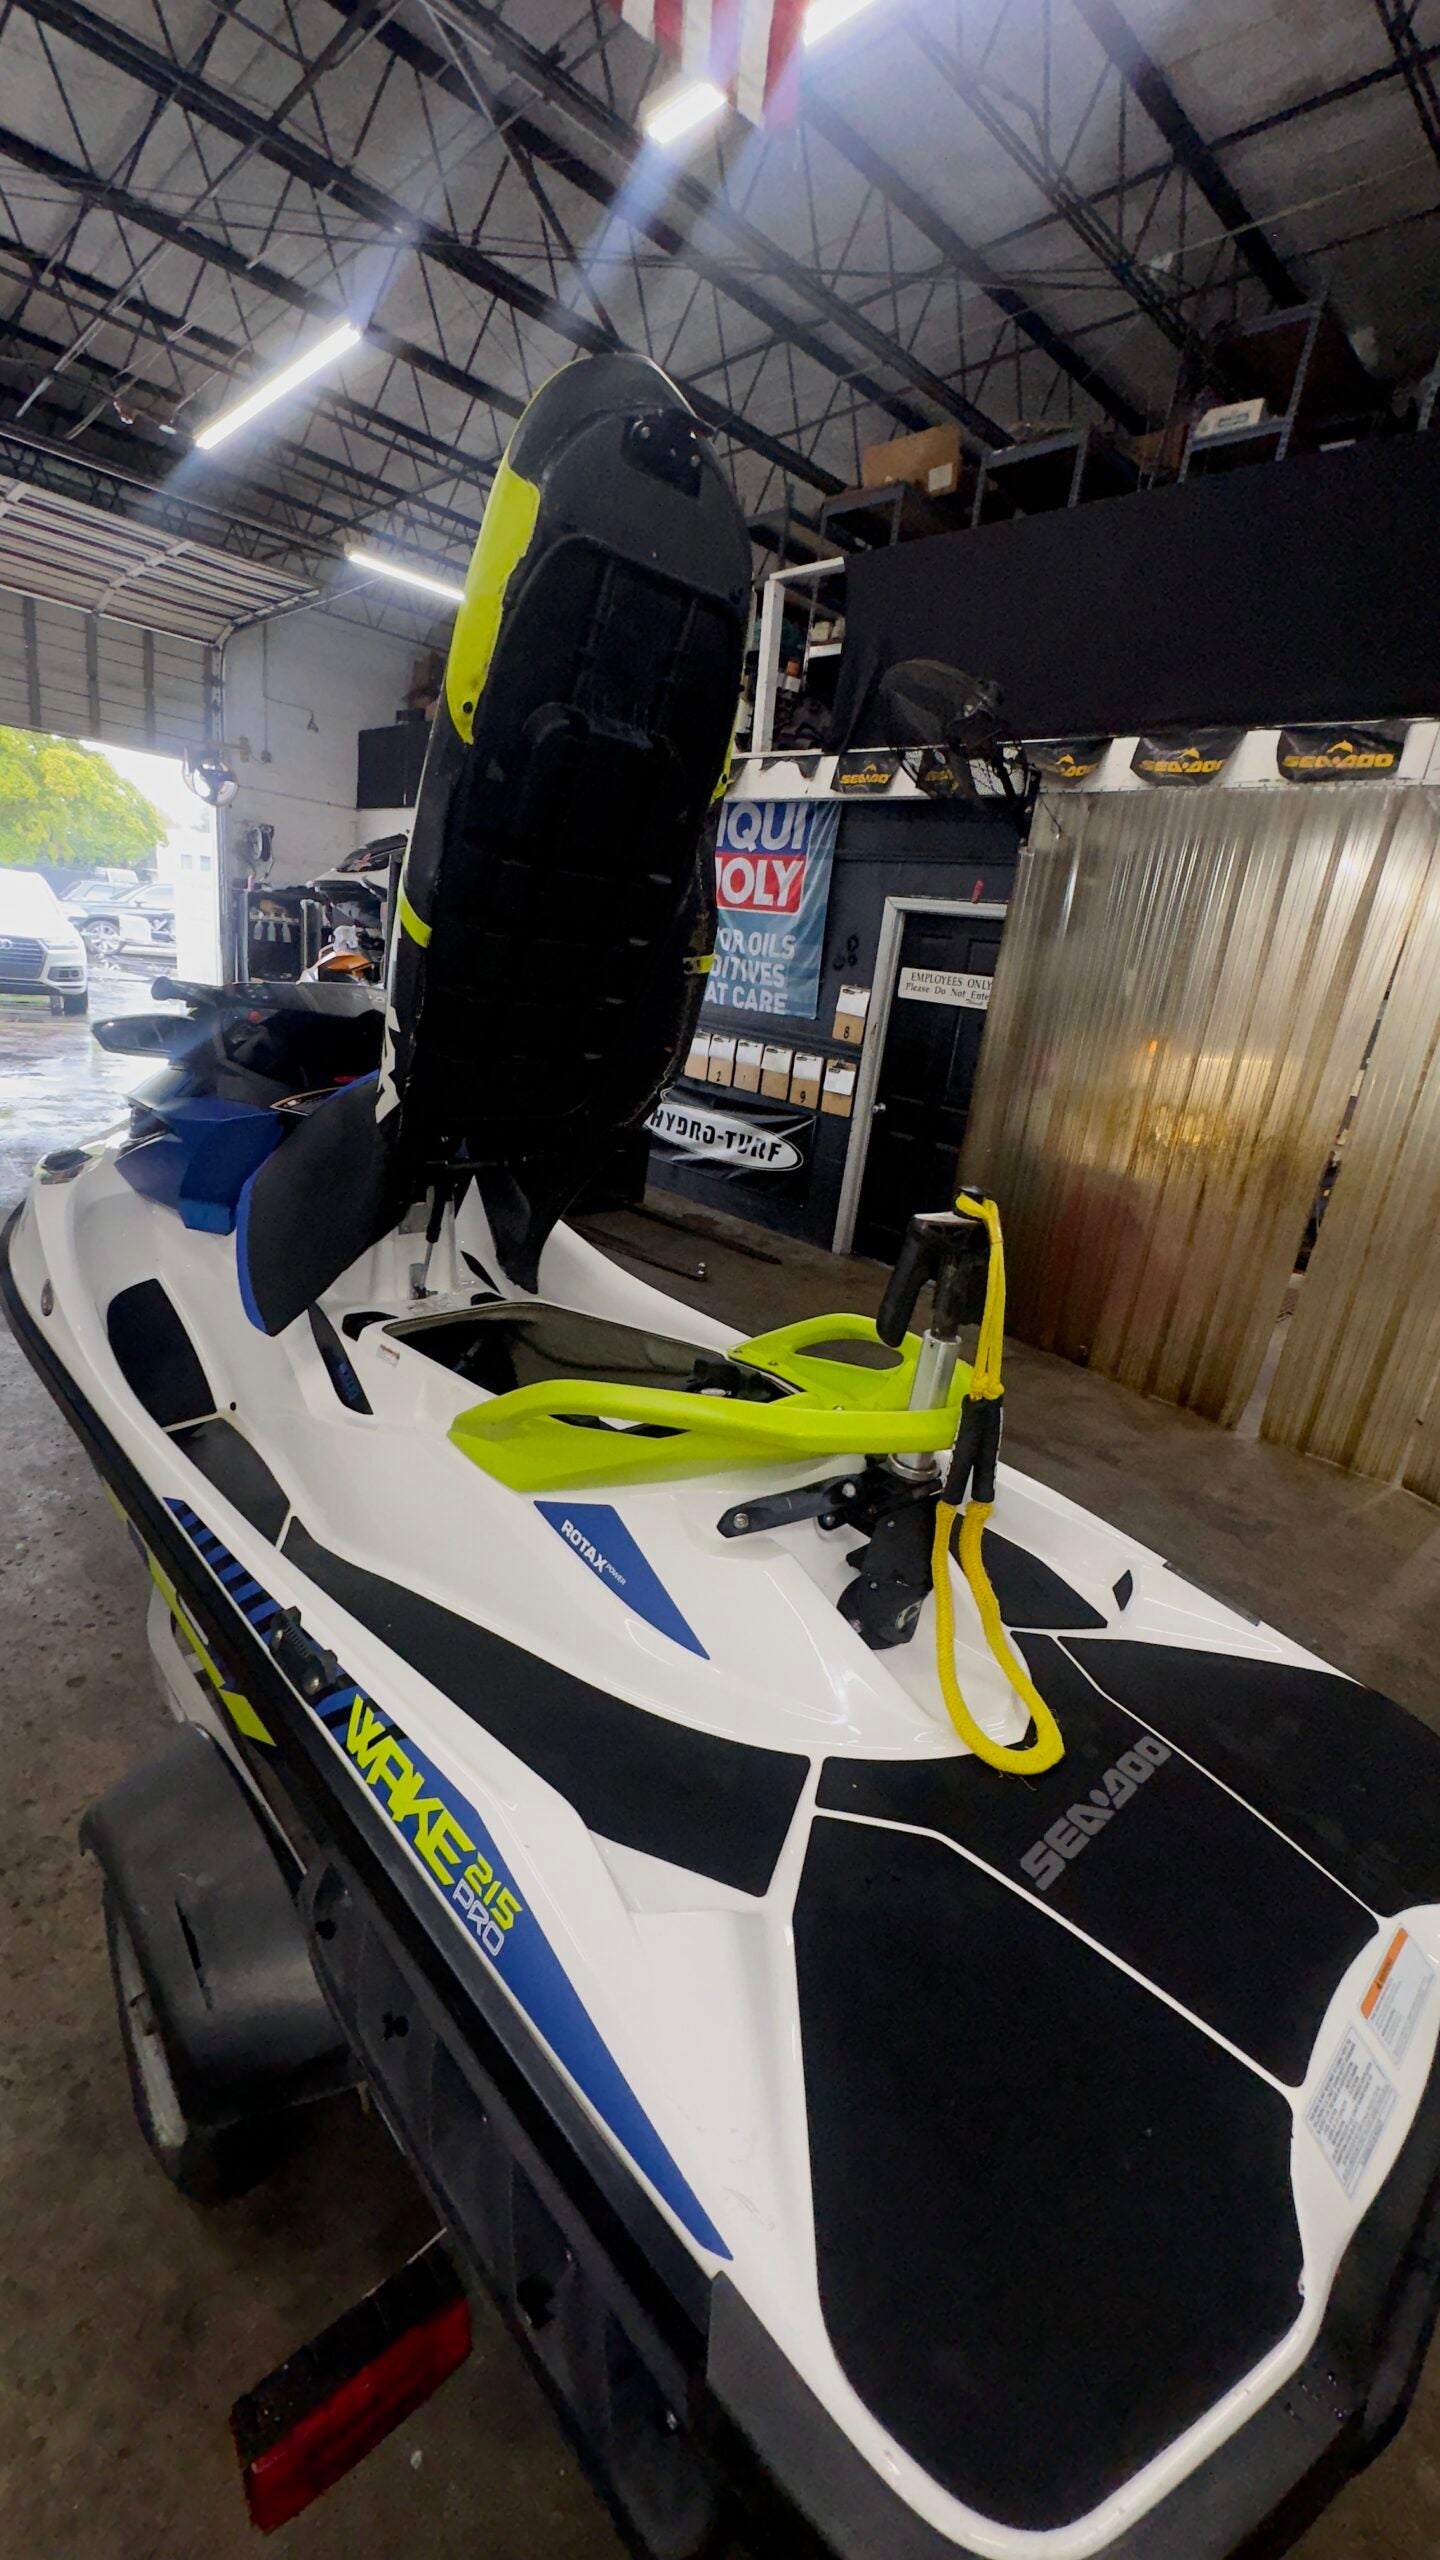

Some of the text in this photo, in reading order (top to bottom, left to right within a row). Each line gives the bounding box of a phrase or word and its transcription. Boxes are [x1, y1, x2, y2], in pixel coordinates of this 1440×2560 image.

[716, 801, 809, 853] IQUI
[715, 856, 804, 906] OLY
[749, 931, 797, 960] OILS
[733, 985, 788, 1015] CARE
[905, 982, 989, 1001] Please Do Not Ente
[911, 972, 993, 991] EMPLOYEES ONLY
[843, 1025, 850, 1039] 8
[800, 1090, 807, 1103] 9
[650, 1108, 783, 1162] HYDRO-TURF
[561, 1519, 627, 1585] ROTAX POWER
[346, 1693, 522, 1930] WAKE 215
[452, 1878, 505, 1957] PRO
